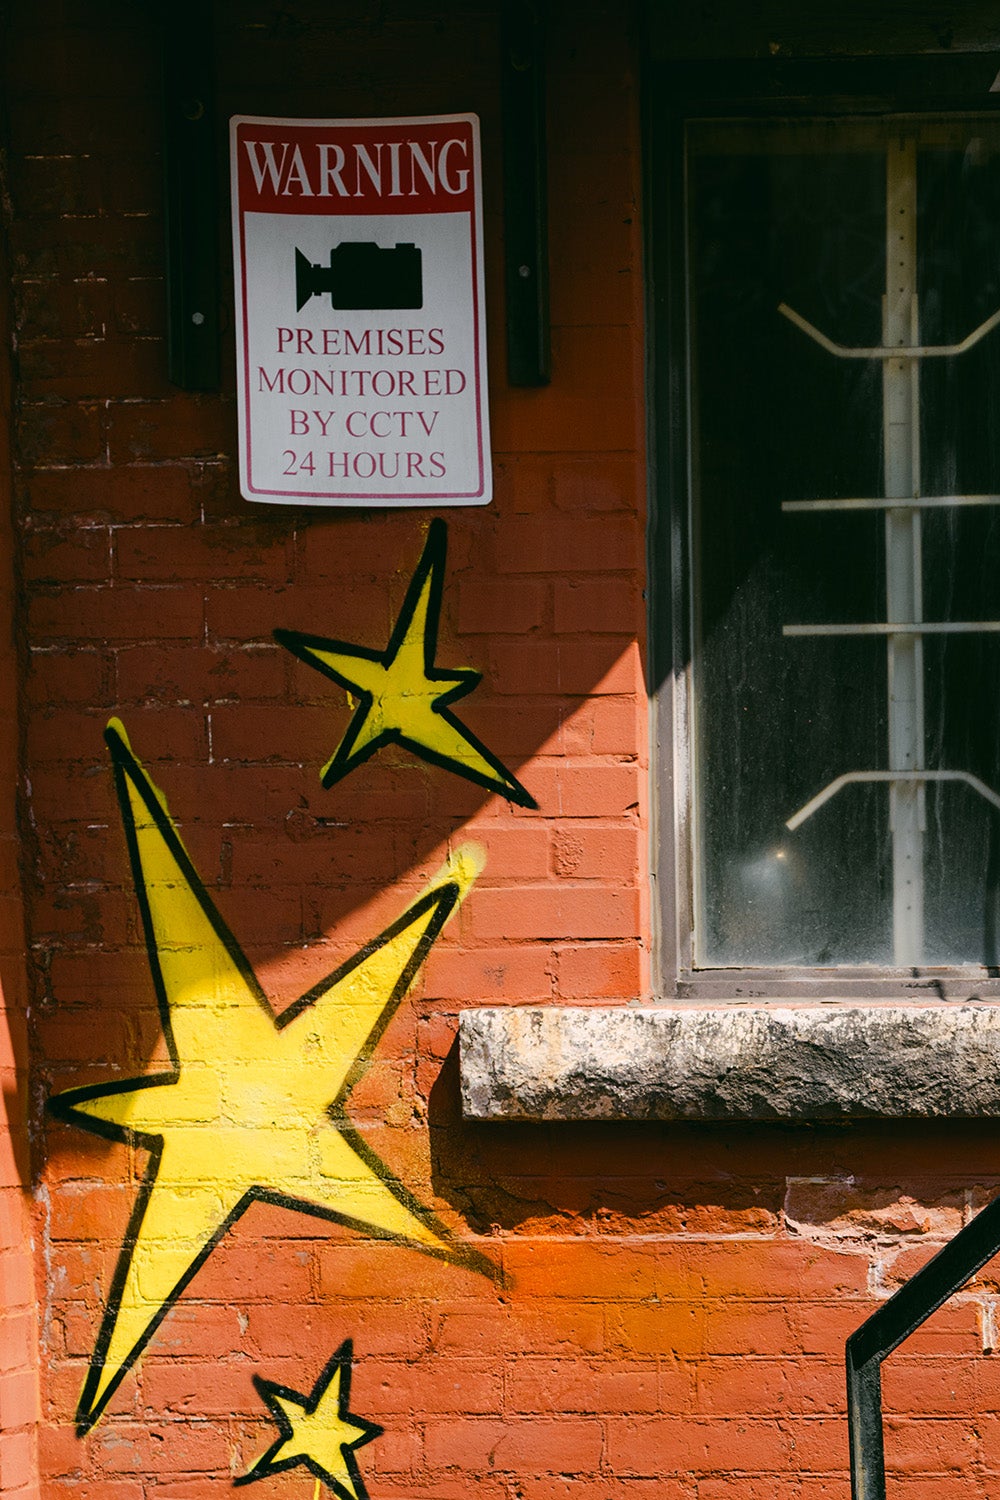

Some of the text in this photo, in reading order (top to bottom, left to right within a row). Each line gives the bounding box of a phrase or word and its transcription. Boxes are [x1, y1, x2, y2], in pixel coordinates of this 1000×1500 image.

[243, 139, 470, 197] WARNING
[276, 326, 445, 356] PREMISES
[258, 366, 466, 397] MONITORED
[289, 409, 440, 438] BY CCTV
[282, 450, 447, 479] 24 HOURS
